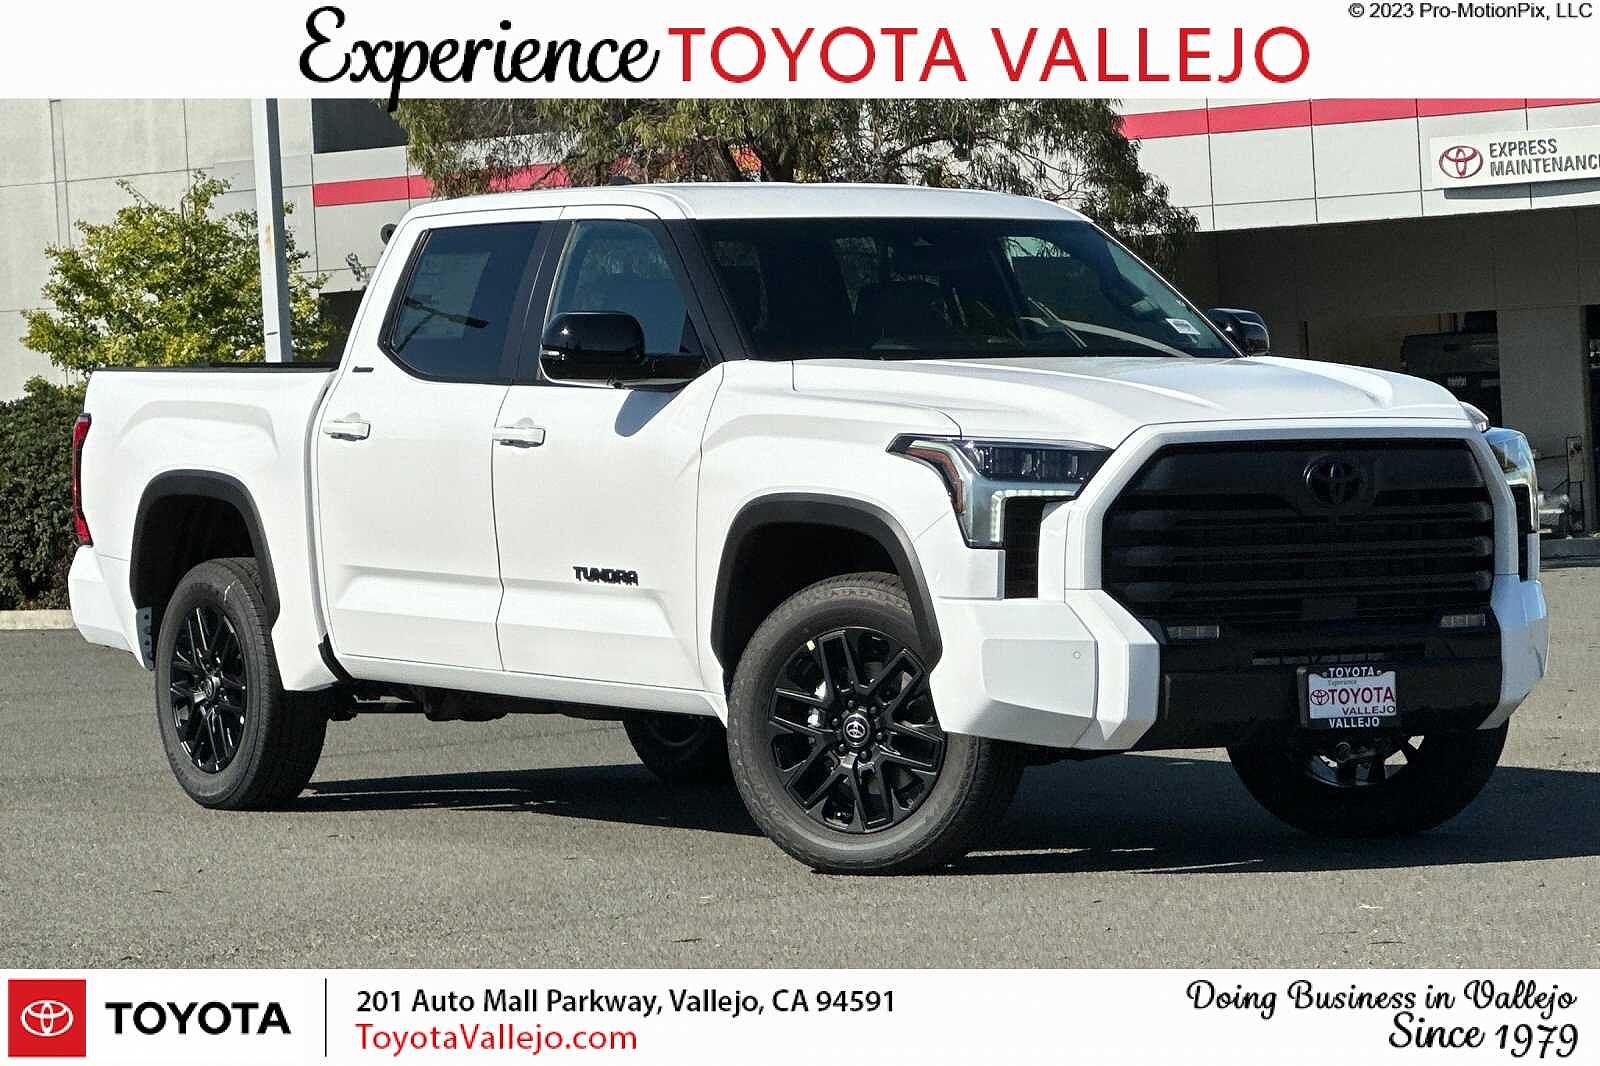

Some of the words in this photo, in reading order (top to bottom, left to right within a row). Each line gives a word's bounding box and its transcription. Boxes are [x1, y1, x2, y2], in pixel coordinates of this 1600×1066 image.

[1489, 138, 1558, 158] EXPRESS
[1490, 153, 1600, 177] MAINTENANC
[573, 566, 639, 586] TUNDRA
[1328, 666, 1375, 678] TOYOTA
[1328, 686, 1395, 705] TOYOTA
[1342, 705, 1396, 716] VALLEJO
[1328, 717, 1381, 729] VALLEJO
